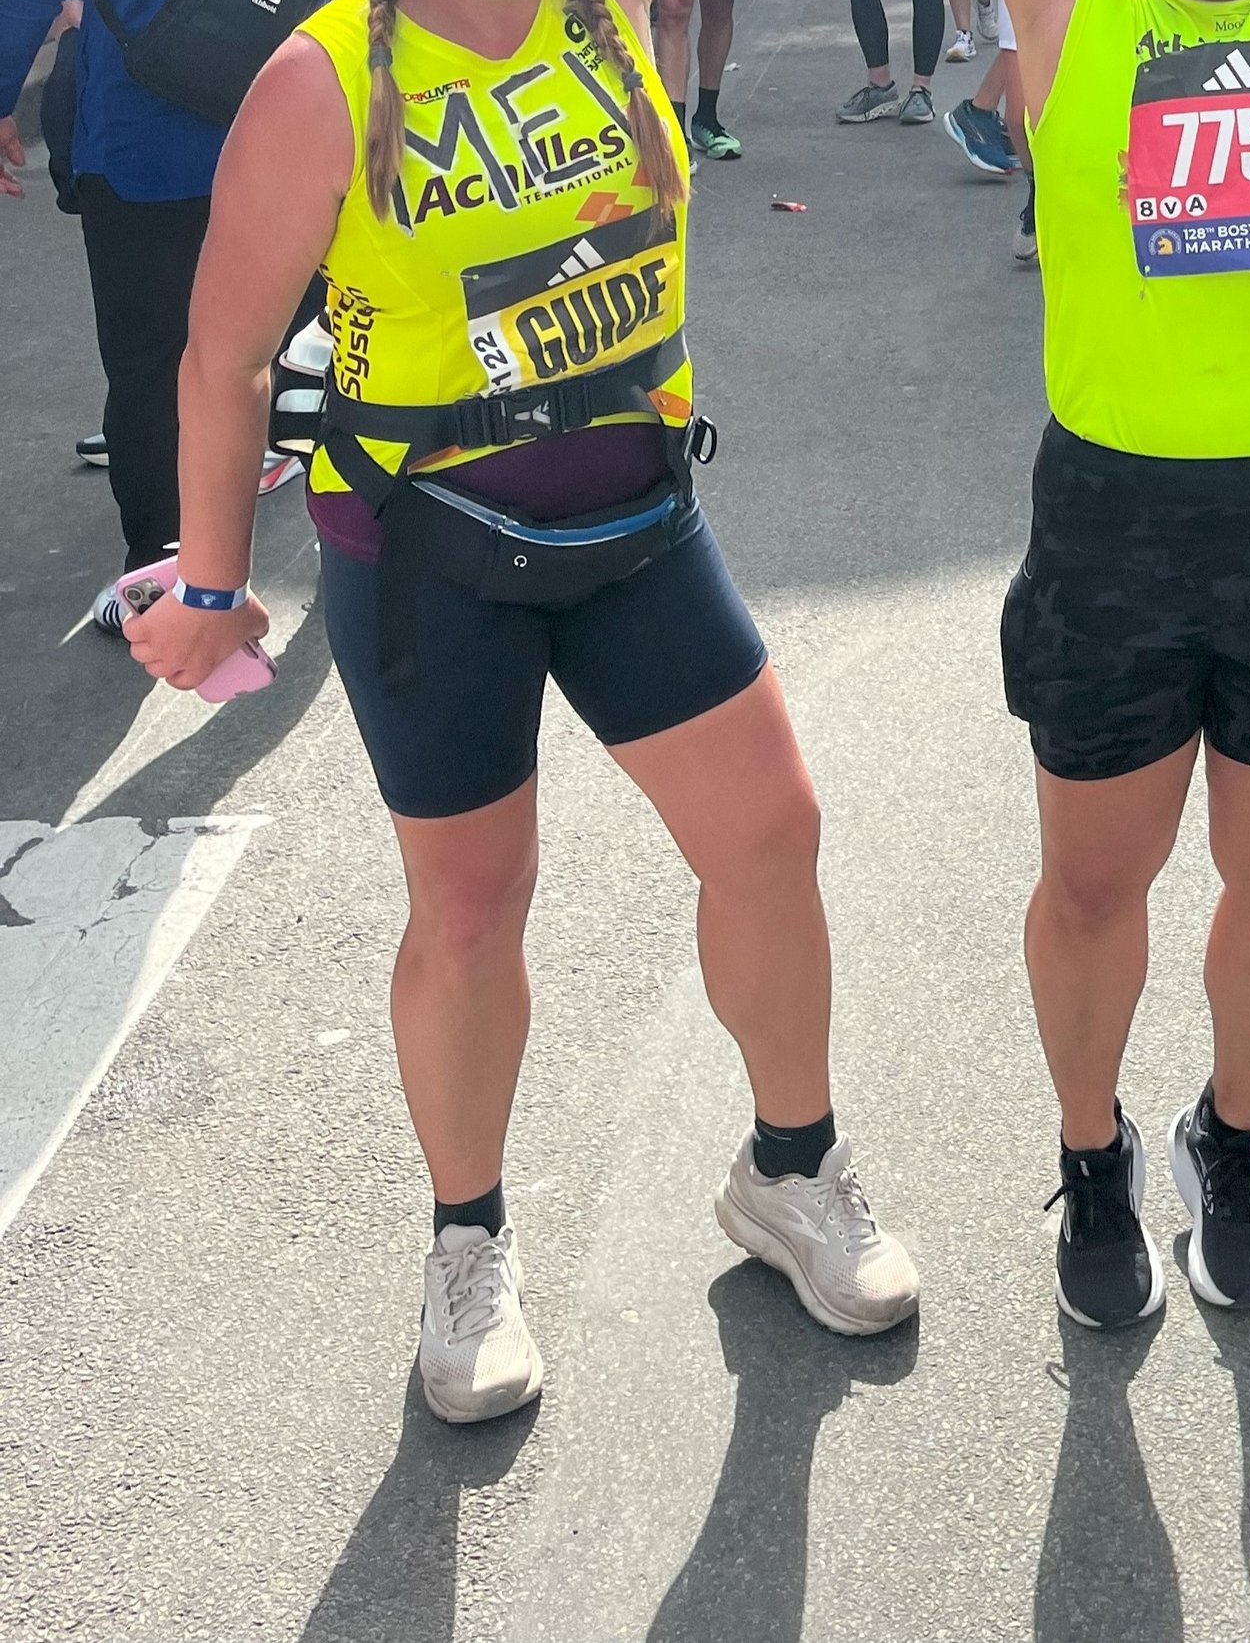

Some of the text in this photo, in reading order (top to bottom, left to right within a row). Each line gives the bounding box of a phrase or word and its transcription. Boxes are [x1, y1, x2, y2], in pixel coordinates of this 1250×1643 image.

[1139, 196, 1205, 218] 8 V A
[1182, 226, 1215, 240] 128TH
[515, 258, 667, 379] GUIDE
